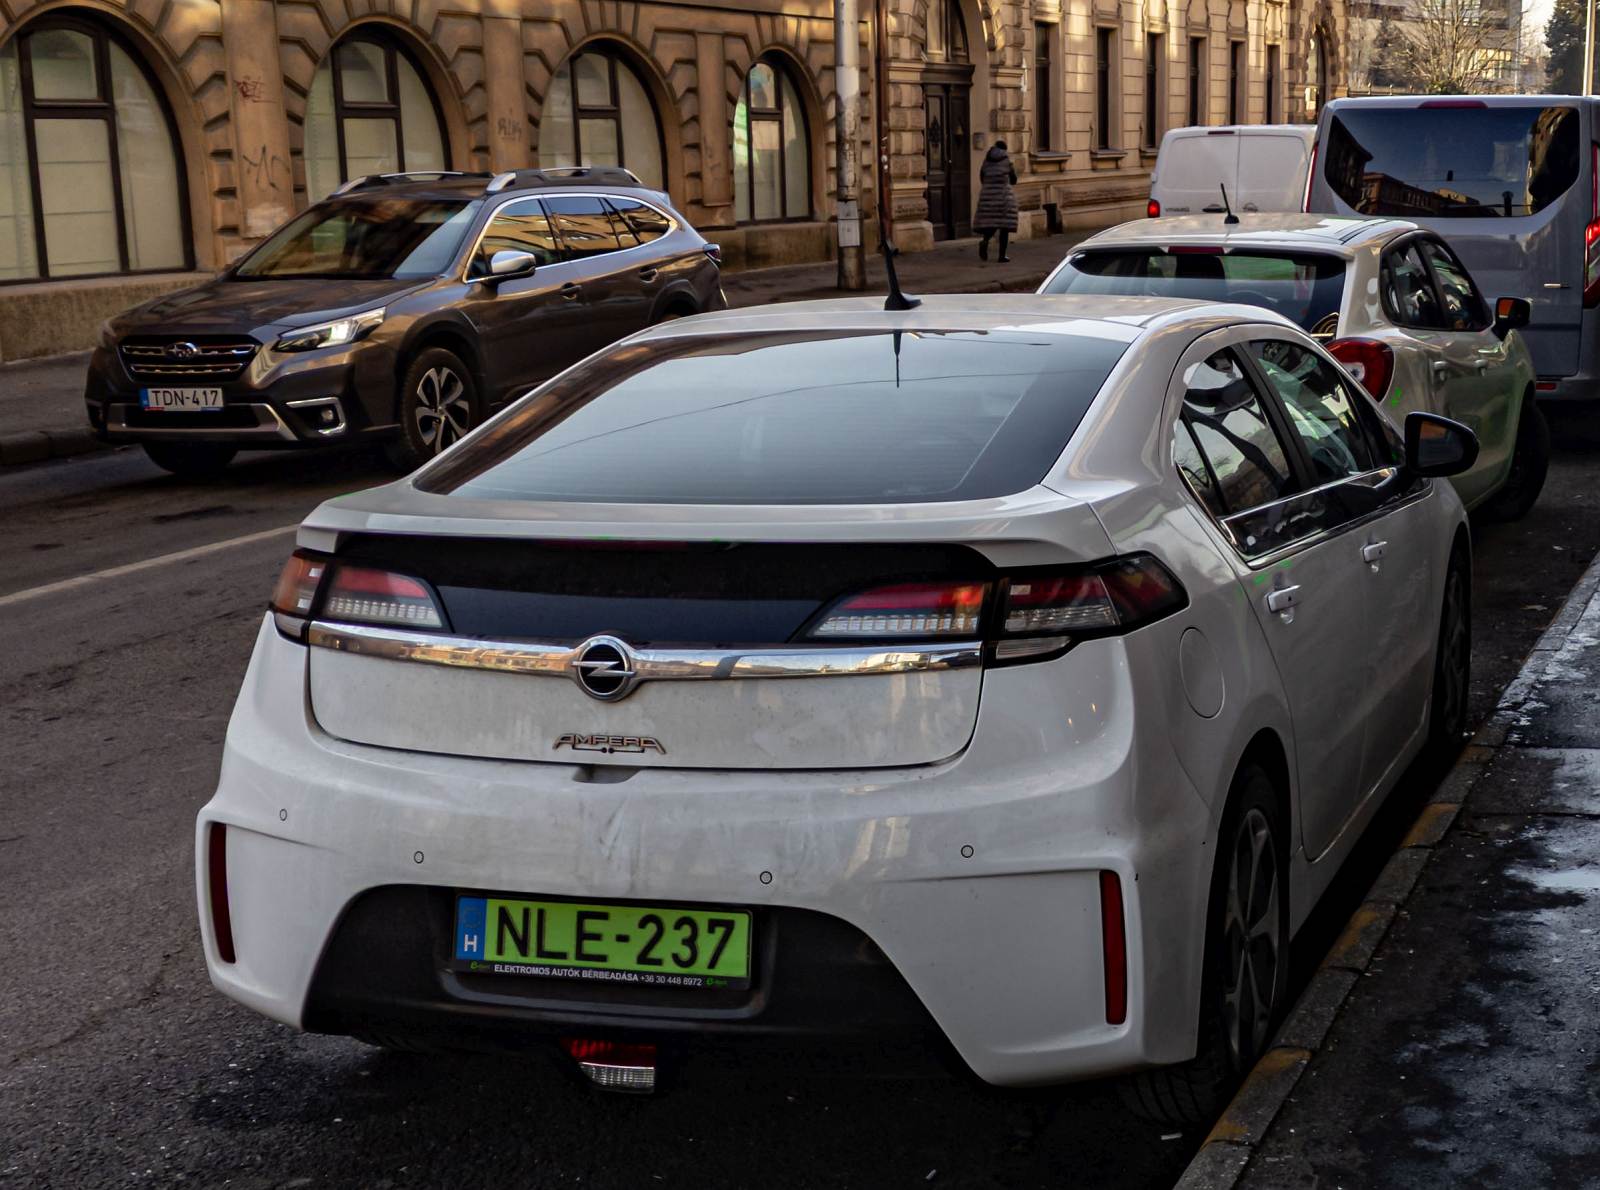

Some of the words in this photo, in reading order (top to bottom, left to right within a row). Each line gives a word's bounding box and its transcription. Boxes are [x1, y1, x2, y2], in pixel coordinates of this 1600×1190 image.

[152, 390, 218, 406] TDN-417
[552, 733, 667, 754] AMPERA
[464, 934, 477, 953] H
[496, 905, 735, 970] NLE-237
[494, 964, 550, 976] ELEKTROMOS
[551, 967, 580, 978] AUTÓK
[582, 969, 639, 982] BÉRBEADÁSA
[656, 975, 666, 984] 30
